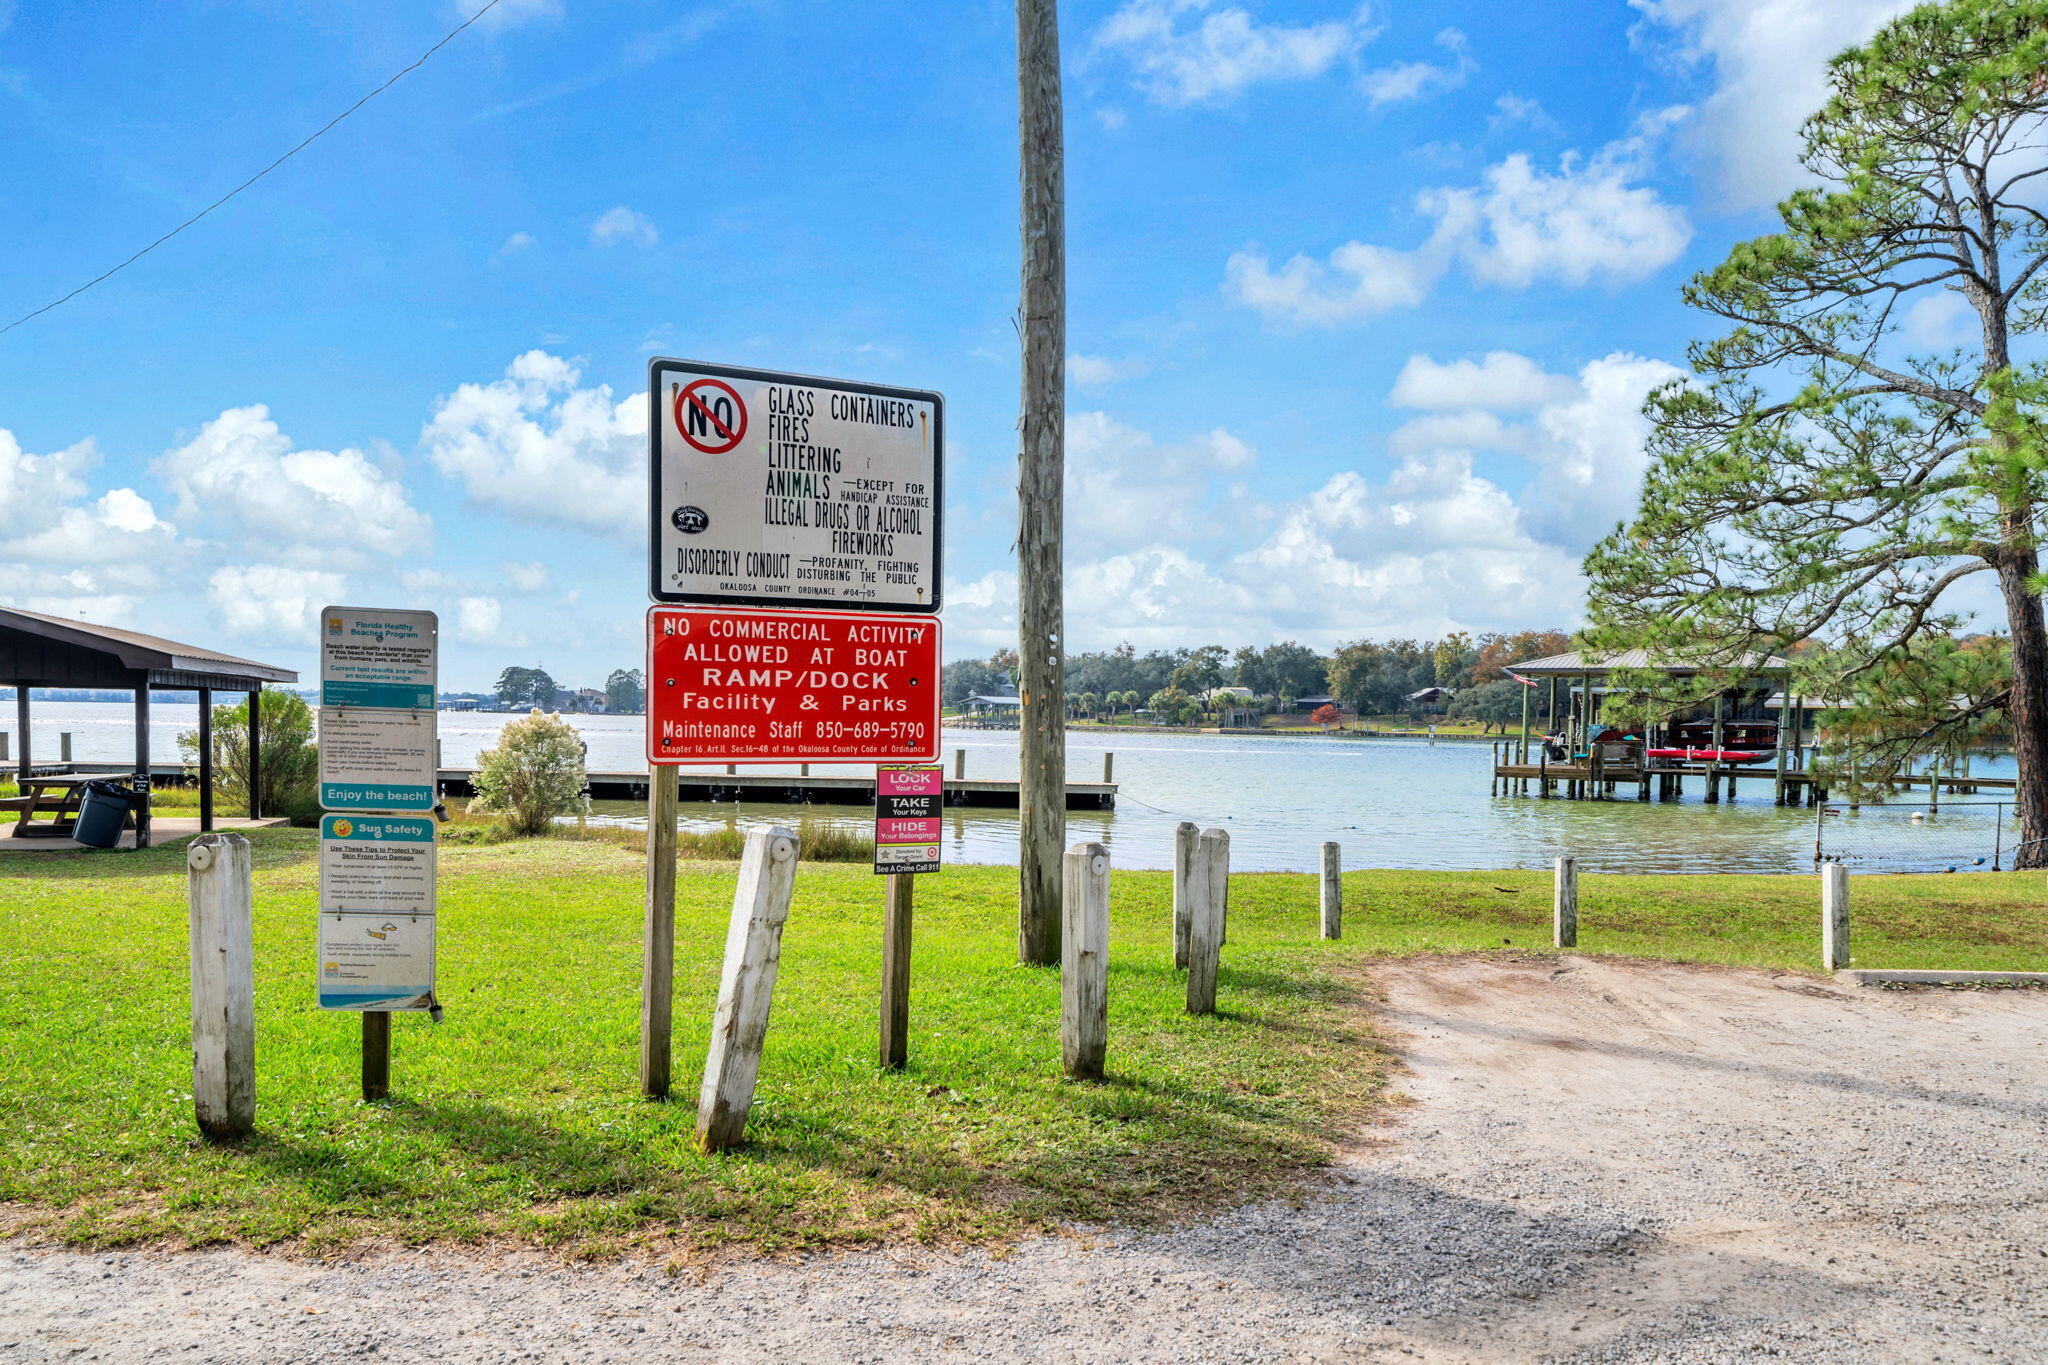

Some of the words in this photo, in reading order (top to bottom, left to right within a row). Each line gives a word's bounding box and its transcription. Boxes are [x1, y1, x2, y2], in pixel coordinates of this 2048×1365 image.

[769, 386, 814, 417] GLASS
[831, 394, 914, 428] CONTAINERS
[688, 395, 732, 439] NO
[769, 415, 809, 443] FIRES
[768, 442, 841, 473] LITTERING
[766, 470, 831, 500] ANIMALS
[905, 483, 925, 495] FOR
[841, 491, 878, 503] HANDICAP
[886, 495, 929, 508] ASSISTANCE
[765, 497, 809, 527] ILLEGAL
[815, 501, 849, 530] DRUGS
[856, 505, 870, 532] OR
[876, 507, 922, 535] ALCOHOL
[832, 531, 894, 557] FIREWORKS
[677, 548, 740, 577] DISORDERLY
[746, 552, 790, 579] CONDUCT
[877, 561, 919, 573] FIGHTING
[797, 568, 850, 582] DISTURBING
[861, 572, 876, 583] THE
[886, 573, 917, 585] PUBLIC
[720, 582, 757, 592] OKALOOSA
[764, 583, 791, 594] COUNTY
[798, 586, 836, 596] ORDINANCE
[384, 622, 413, 632] Healthy
[386, 630, 418, 639] Program
[664, 618, 690, 636] NO
[710, 620, 831, 641] COMMERCIAL
[848, 626, 925, 645] ACTIVITY
[684, 644, 788, 663] ALLOWED
[811, 648, 834, 665] AT
[855, 649, 907, 667] BOAT
[703, 669, 889, 690] RAMP/DOCK
[683, 692, 776, 714] Facility
[800, 695, 820, 710] &
[842, 695, 907, 712] Parks
[663, 721, 756, 738] Maintenance
[769, 721, 803, 738] Staff
[816, 722, 925, 739] 850-689-5790
[662, 745, 692, 755] Chapter
[772, 745, 779, 753] of
[783, 745, 794, 753] the
[798, 744, 829, 753] Okaloosa
[833, 745, 858, 755] County
[862, 745, 877, 753] Code
[880, 745, 886, 753] of
[892, 745, 926, 753] Ordinance
[890, 774, 930, 783] LOCK
[328, 789, 362, 801] Enjoy
[366, 790, 384, 800] the
[388, 791, 427, 800] beach!
[890, 798, 930, 808] TAKE
[359, 824, 381, 832] Sun
[385, 824, 423, 836] Safety
[892, 822, 926, 831] HIDE
